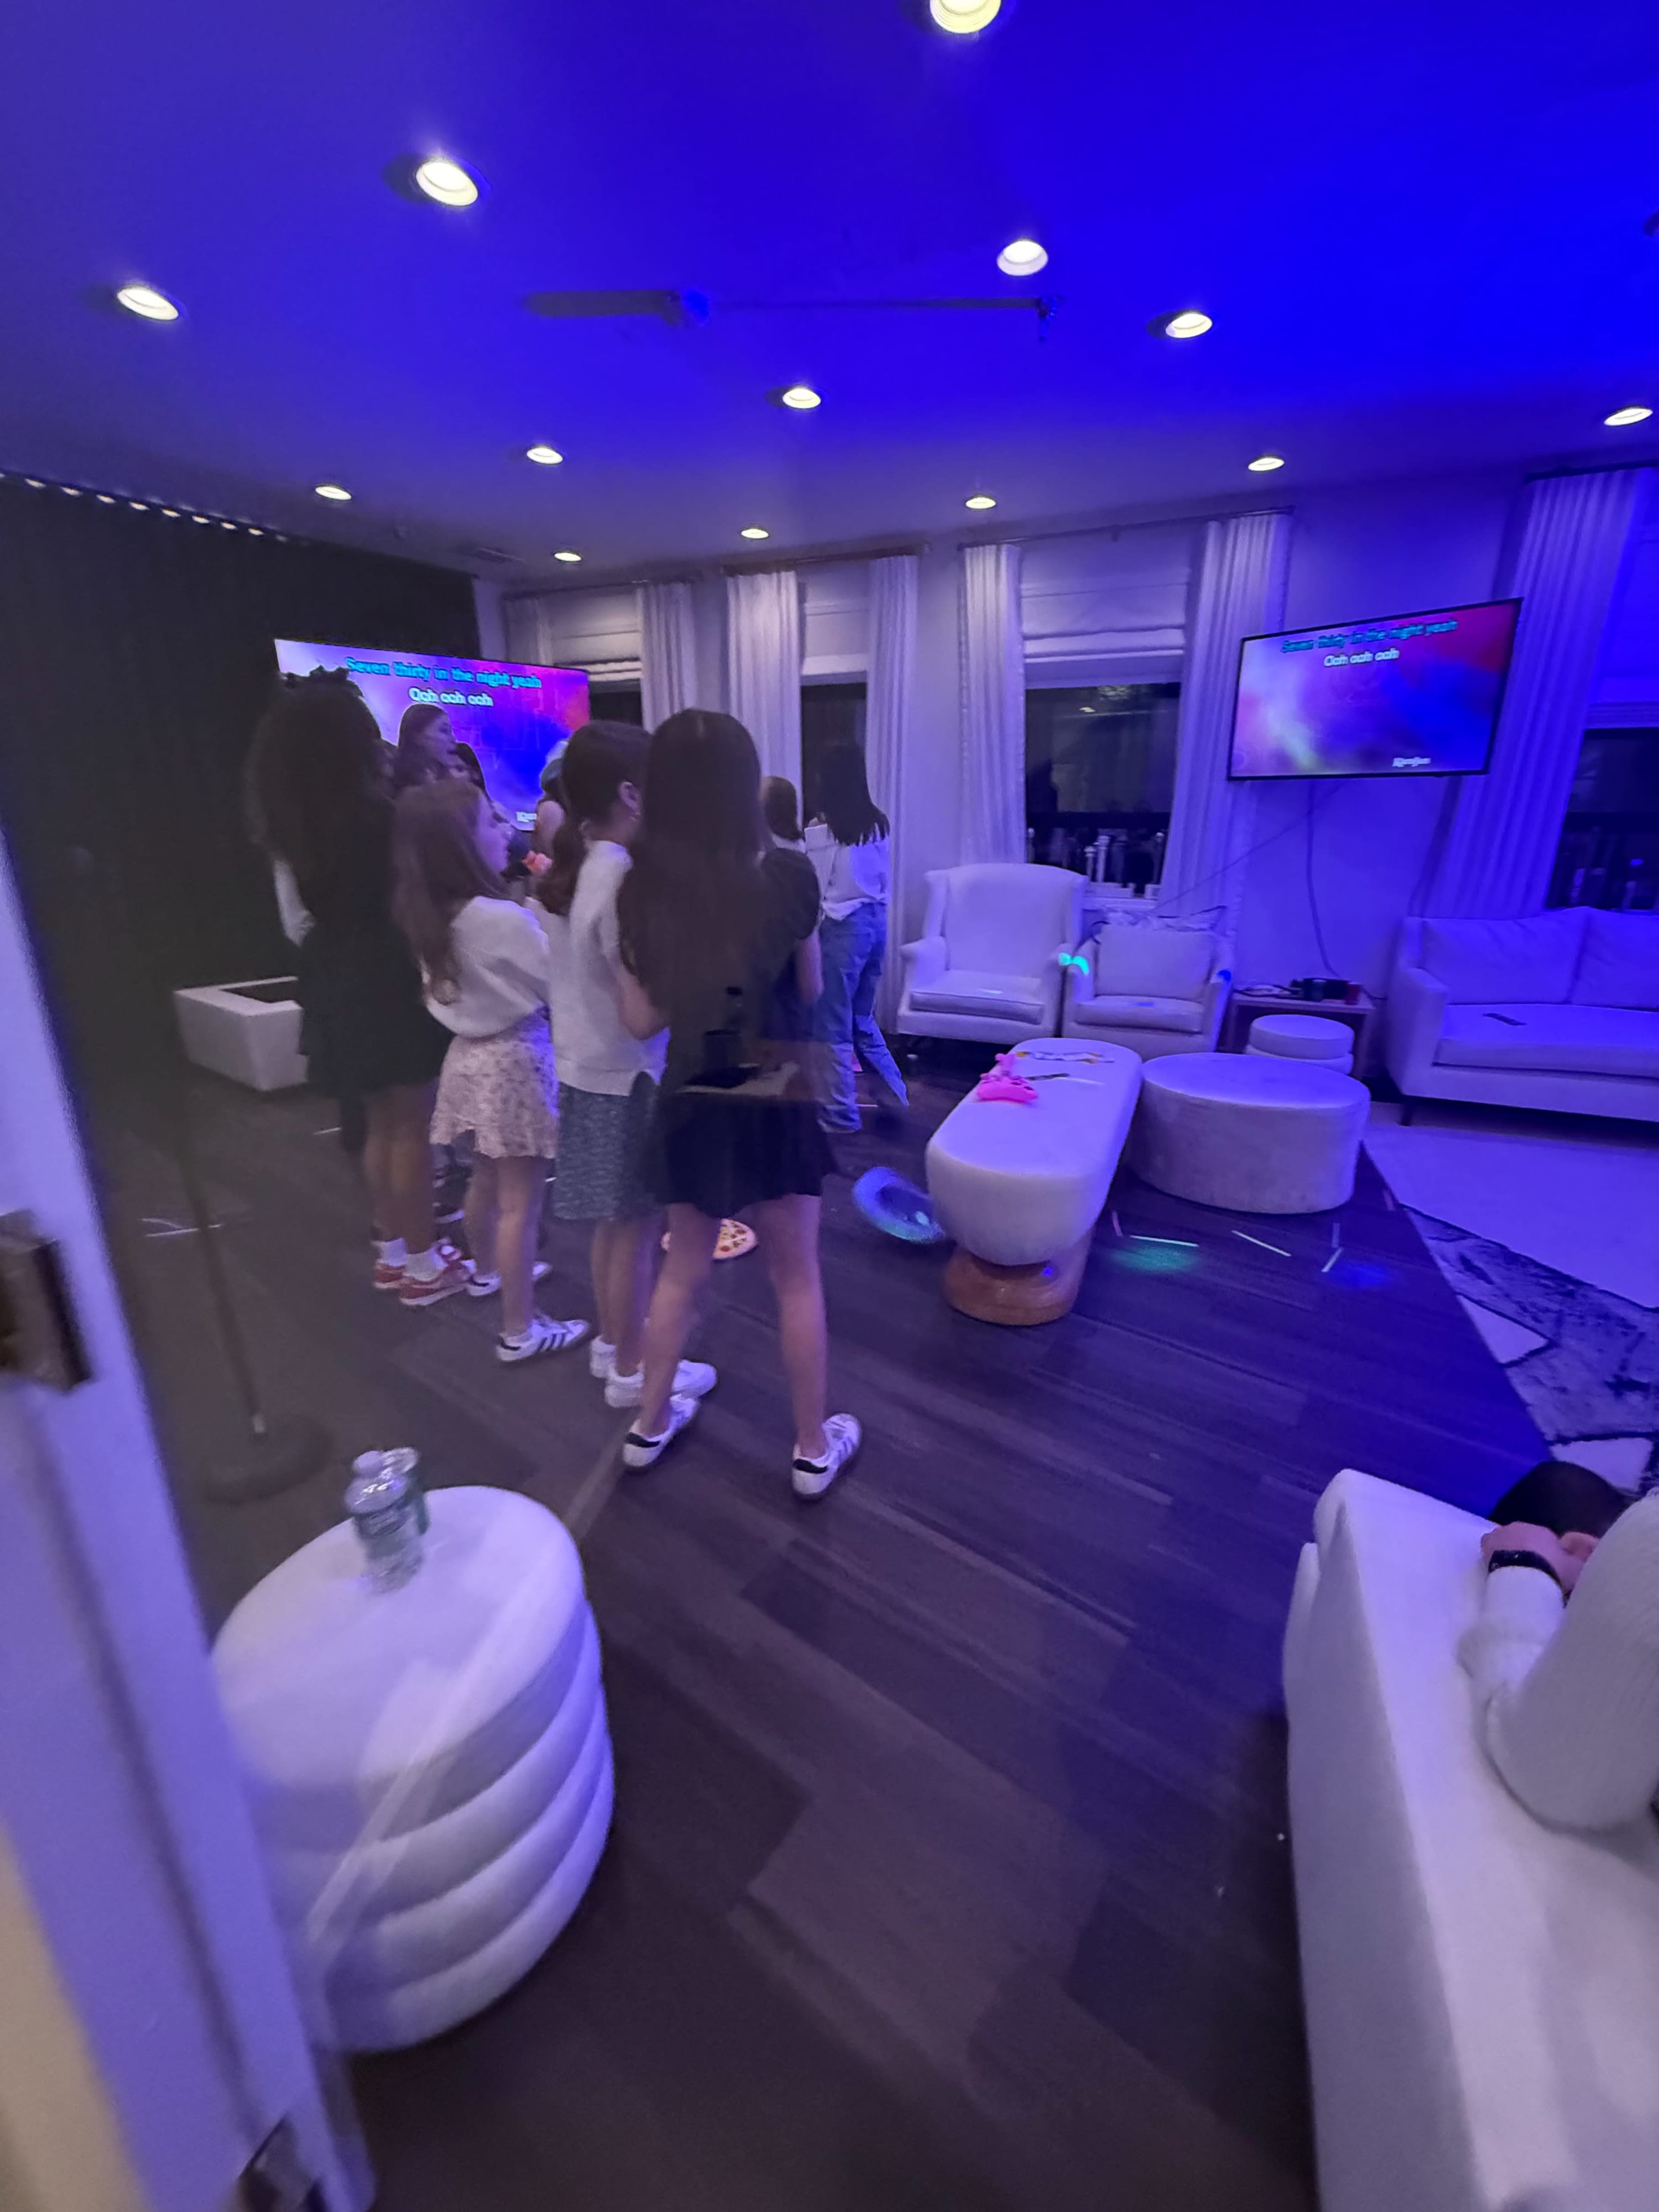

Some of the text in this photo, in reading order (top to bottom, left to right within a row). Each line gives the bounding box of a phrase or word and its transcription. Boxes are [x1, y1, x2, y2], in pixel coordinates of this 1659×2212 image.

[346, 656, 542, 689] Seven thirty in the night yeah
